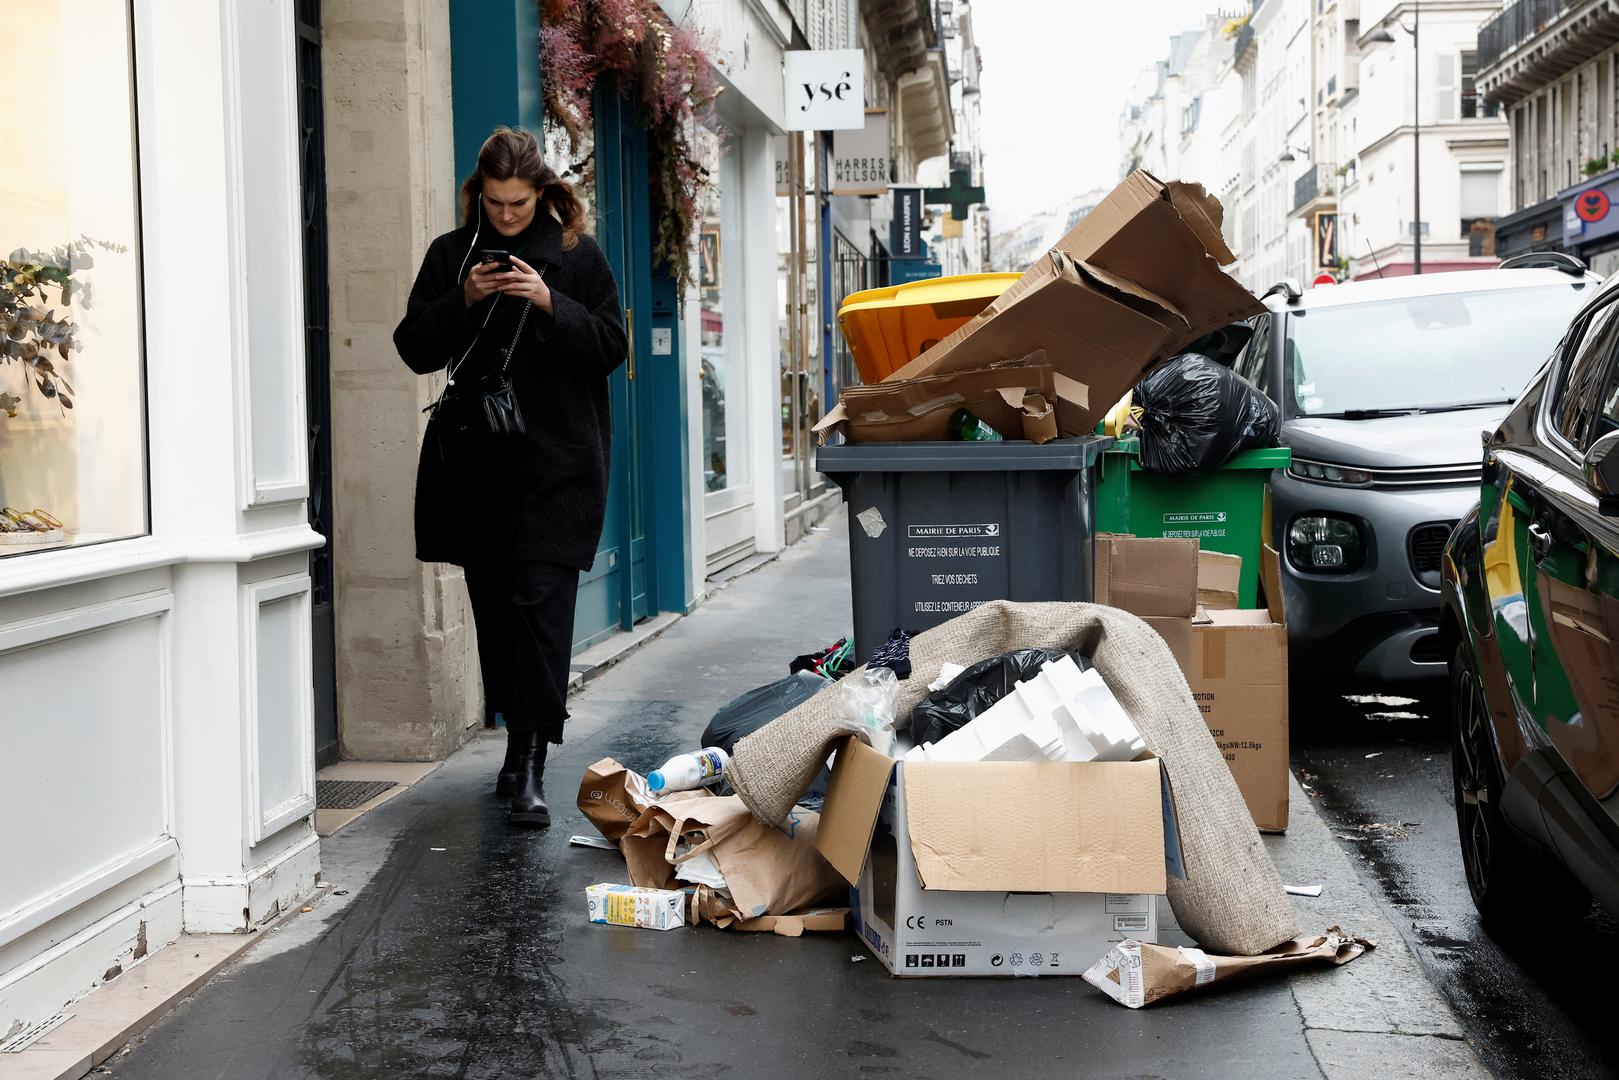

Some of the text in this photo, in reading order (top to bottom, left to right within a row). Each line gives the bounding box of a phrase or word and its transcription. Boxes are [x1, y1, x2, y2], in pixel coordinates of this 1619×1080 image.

[801, 72, 851, 112] ysé
[836, 158, 884, 169] HARRIS
[836, 170, 885, 182] WILSON
[903, 232, 911, 253] LEON
[916, 526, 982, 535] MAIRIE DE PARIS
[908, 546, 1000, 557] NE DEPOSEZ RIEN SUR LA VOIE PUBLIQUE
[931, 574, 978, 585] TRIEZ VOS DECHETS
[914, 601, 935, 612] UTILISEZ
[935, 601, 941, 612] LE
[941, 601, 970, 612] CONTENEUR
[1192, 693, 1215, 701] MOTION
[1210, 729, 1224, 737] 2CM
